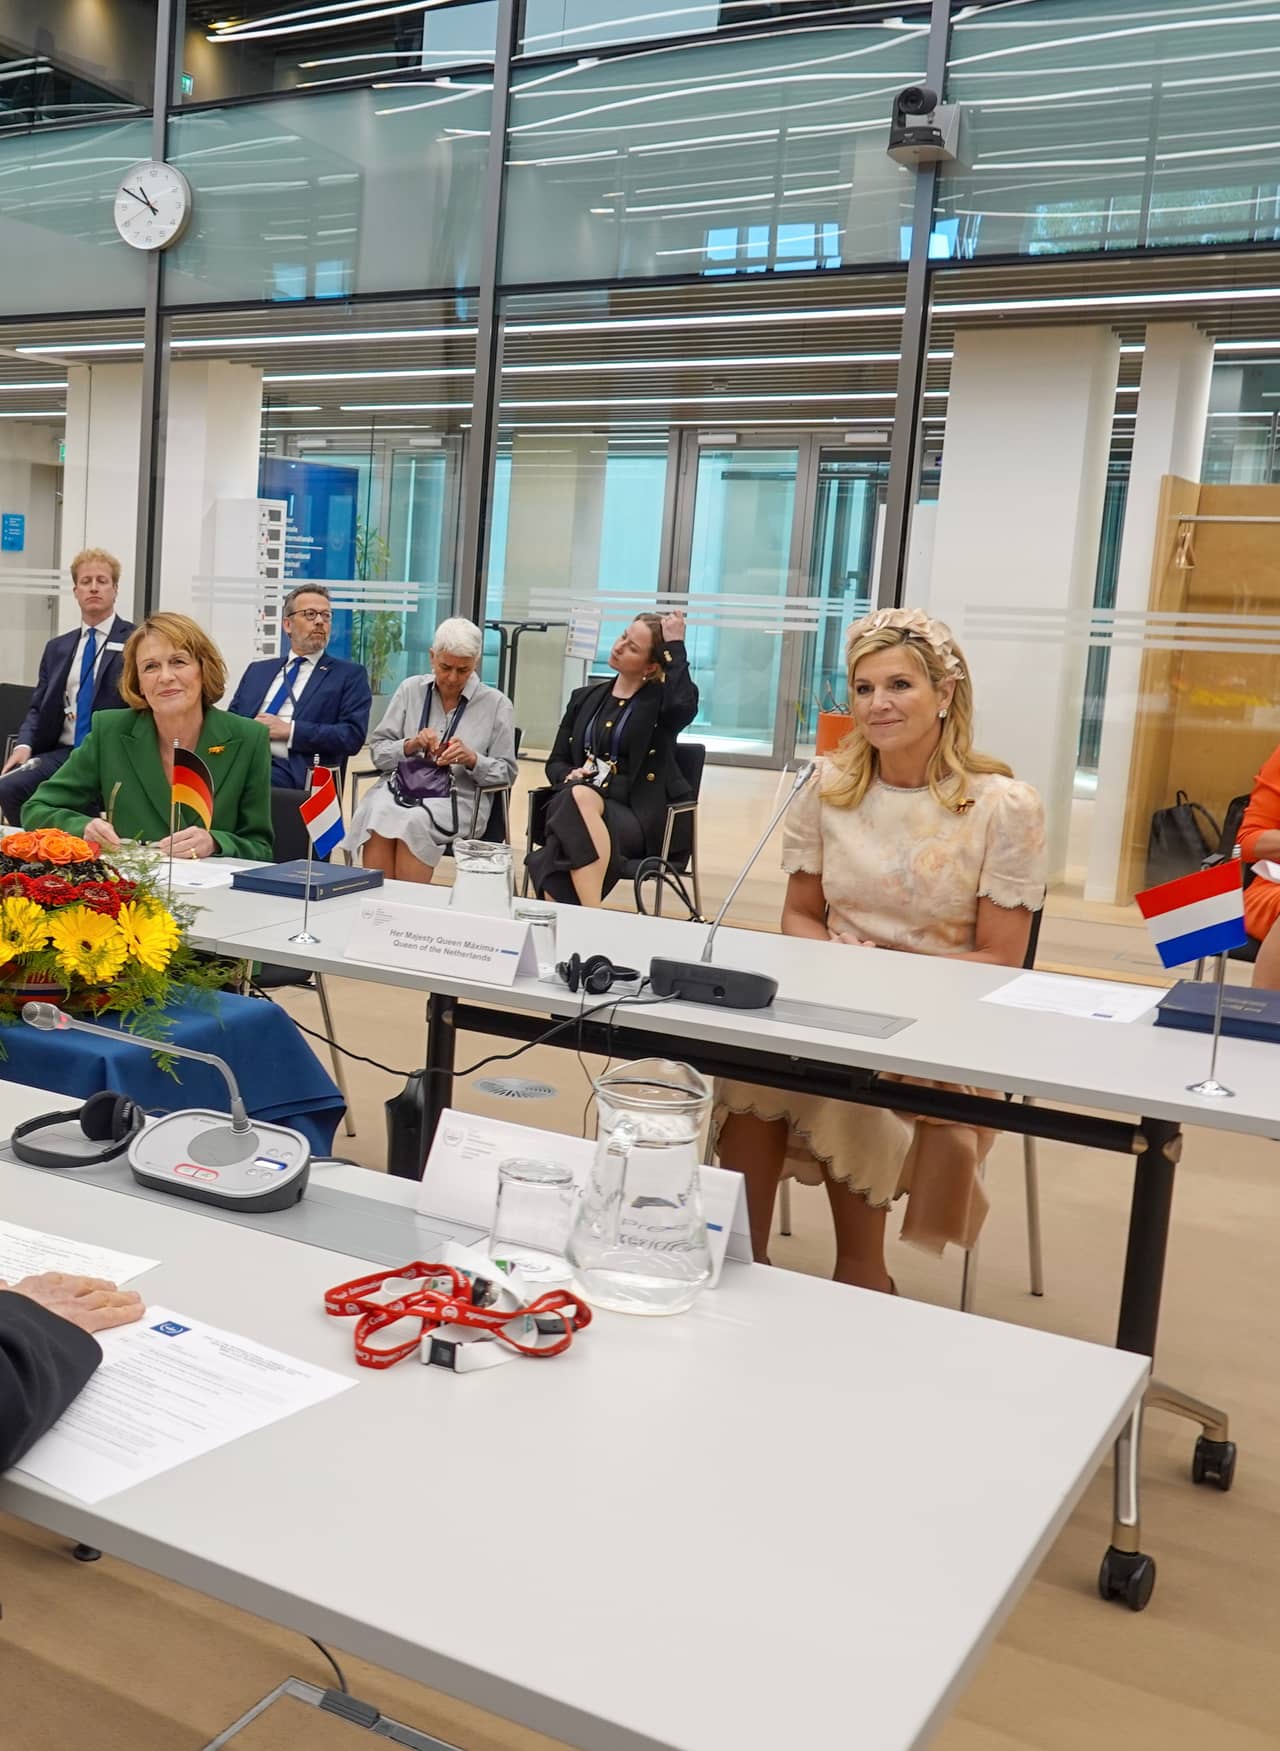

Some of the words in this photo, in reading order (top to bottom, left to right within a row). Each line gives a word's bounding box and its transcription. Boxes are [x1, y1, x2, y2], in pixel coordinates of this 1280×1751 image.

[389, 929, 403, 937] Her
[405, 931, 435, 944] Majesty
[436, 936, 462, 947] Queen
[393, 939, 418, 950] Queen
[429, 945, 442, 954] the
[443, 948, 492, 962] Netherlands
